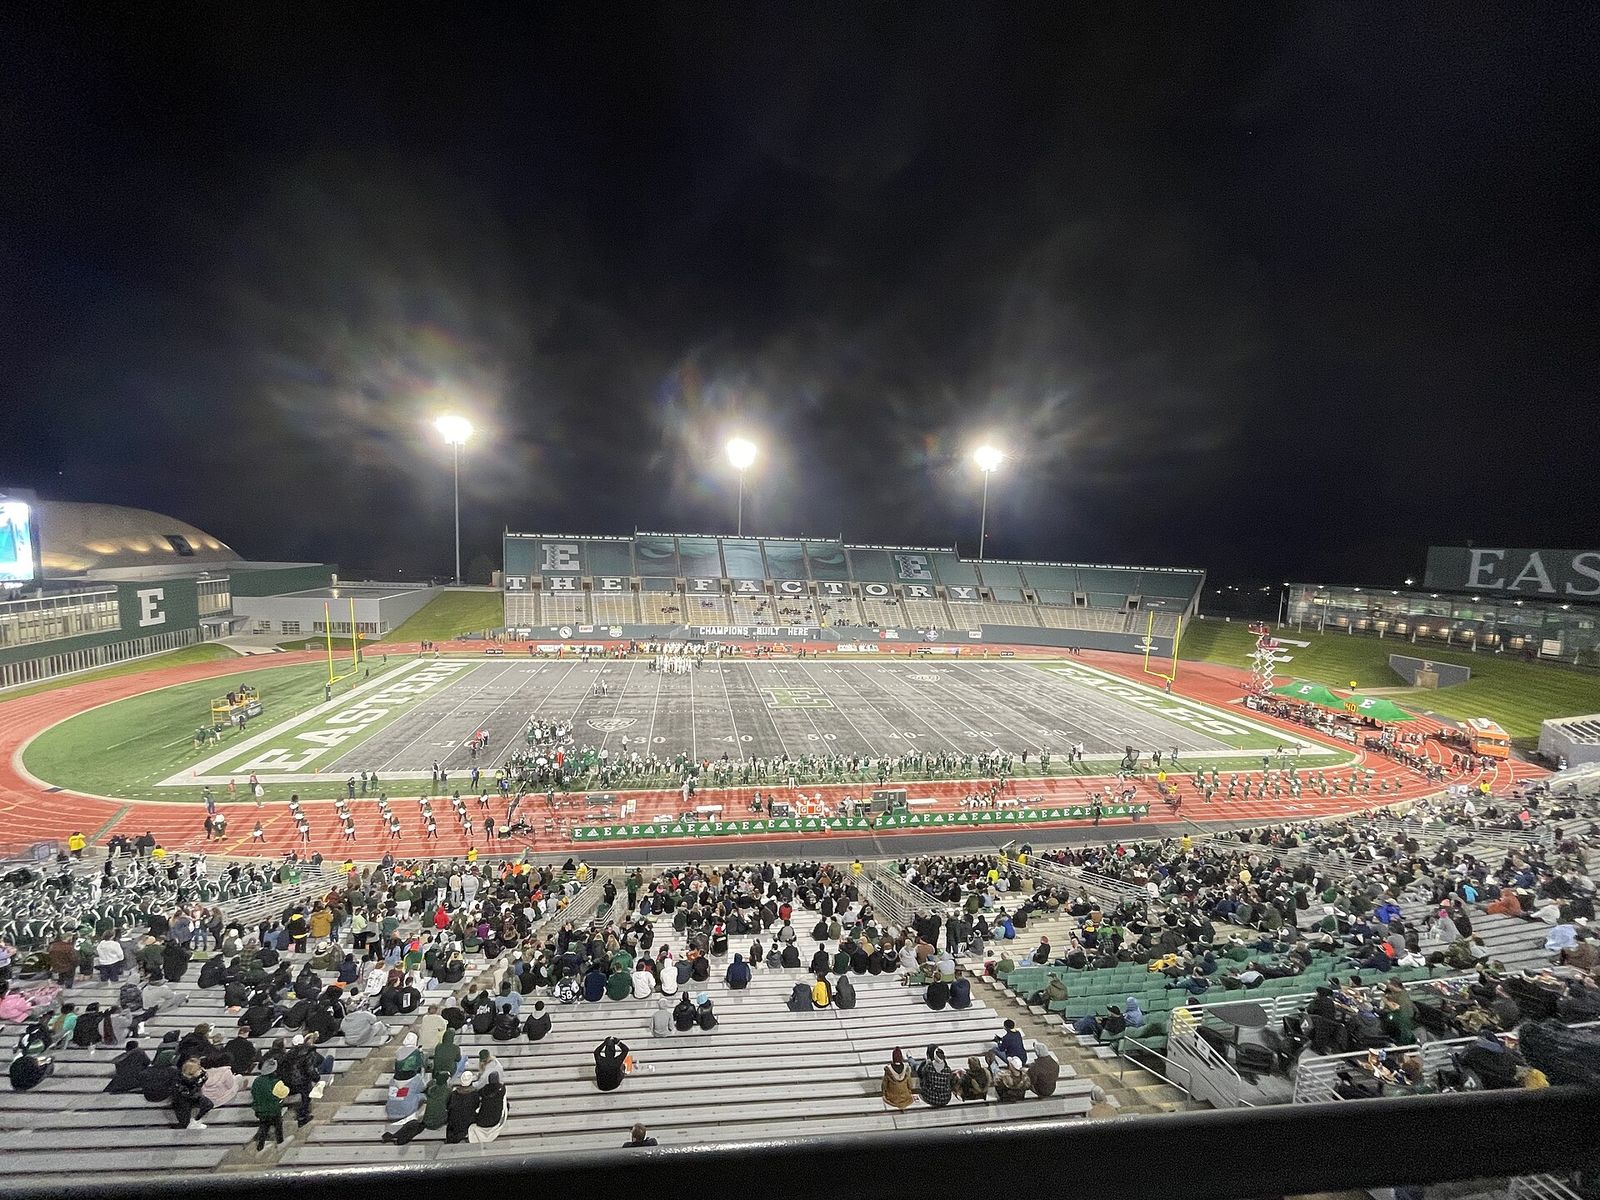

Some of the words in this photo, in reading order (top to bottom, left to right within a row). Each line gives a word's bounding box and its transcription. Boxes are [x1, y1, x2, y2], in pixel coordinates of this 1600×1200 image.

[542, 544, 580, 570] E
[895, 555, 932, 580] E
[1465, 549, 1600, 596] EAS
[506, 577, 622, 590] THE
[694, 579, 973, 599] FACTORY
[137, 588, 166, 627] E
[700, 626, 749, 636] CHAMPIONS
[757, 626, 780, 636] BUILT
[788, 627, 809, 636] HERE
[1422, 660, 1433, 671] E
[1298, 685, 1312, 695] E
[760, 687, 834, 708] E
[1045, 668, 1250, 736] EAGLES
[1359, 699, 1375, 709] E
[231, 661, 471, 773] EASTERN
[633, 736, 666, 744] 30
[722, 734, 754, 743] 40
[807, 733, 837, 741] 50
[888, 731, 918, 739] 40
[560, 990, 573, 1000] 58
